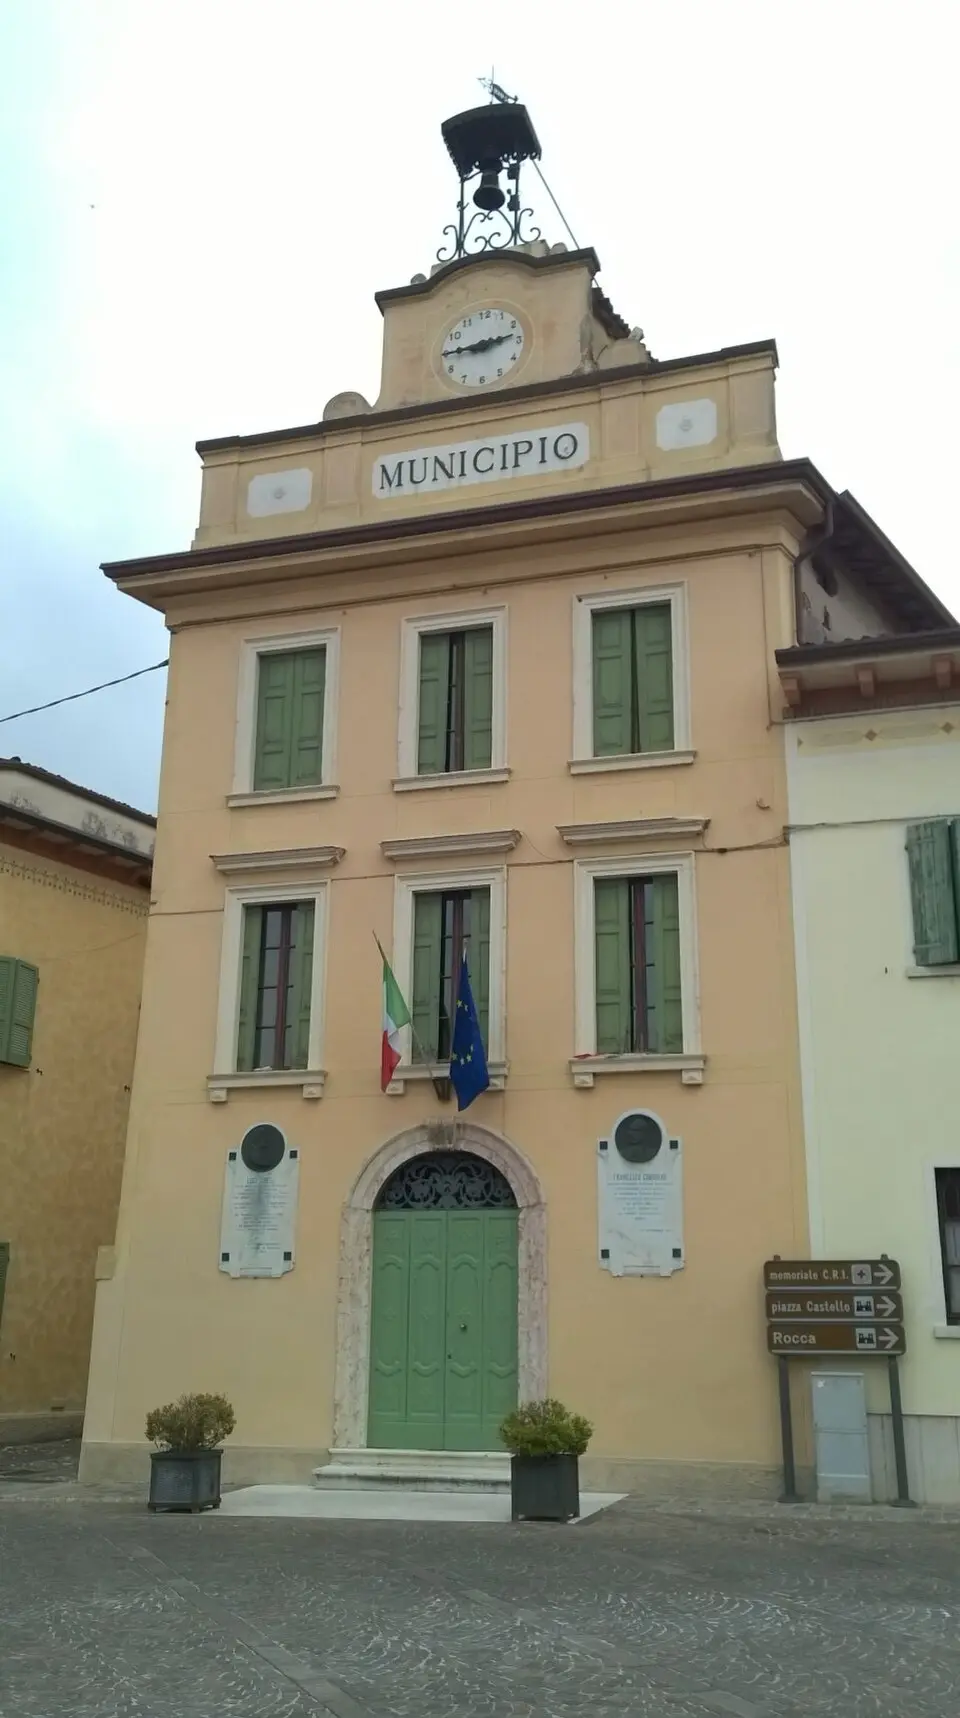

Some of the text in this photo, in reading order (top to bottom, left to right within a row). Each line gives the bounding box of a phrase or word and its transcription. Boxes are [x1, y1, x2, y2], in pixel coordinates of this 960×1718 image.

[479, 310, 492, 320] 12
[500, 312, 504, 320] 1
[462, 318, 472, 328] 11
[511, 320, 516, 328] 2
[450, 331, 461, 341] 10
[516, 336, 522, 344] 3
[510, 352, 516, 361] 4
[448, 365, 454, 373] 8
[497, 368, 503, 376] 5
[461, 374, 468, 383] 7
[379, 433, 578, 489] MUNICIPIO
[770, 1269, 848, 1280] memoriale C.R.I.
[772, 1300, 850, 1314] piazza Castello
[772, 1332, 816, 1344] Rocca
